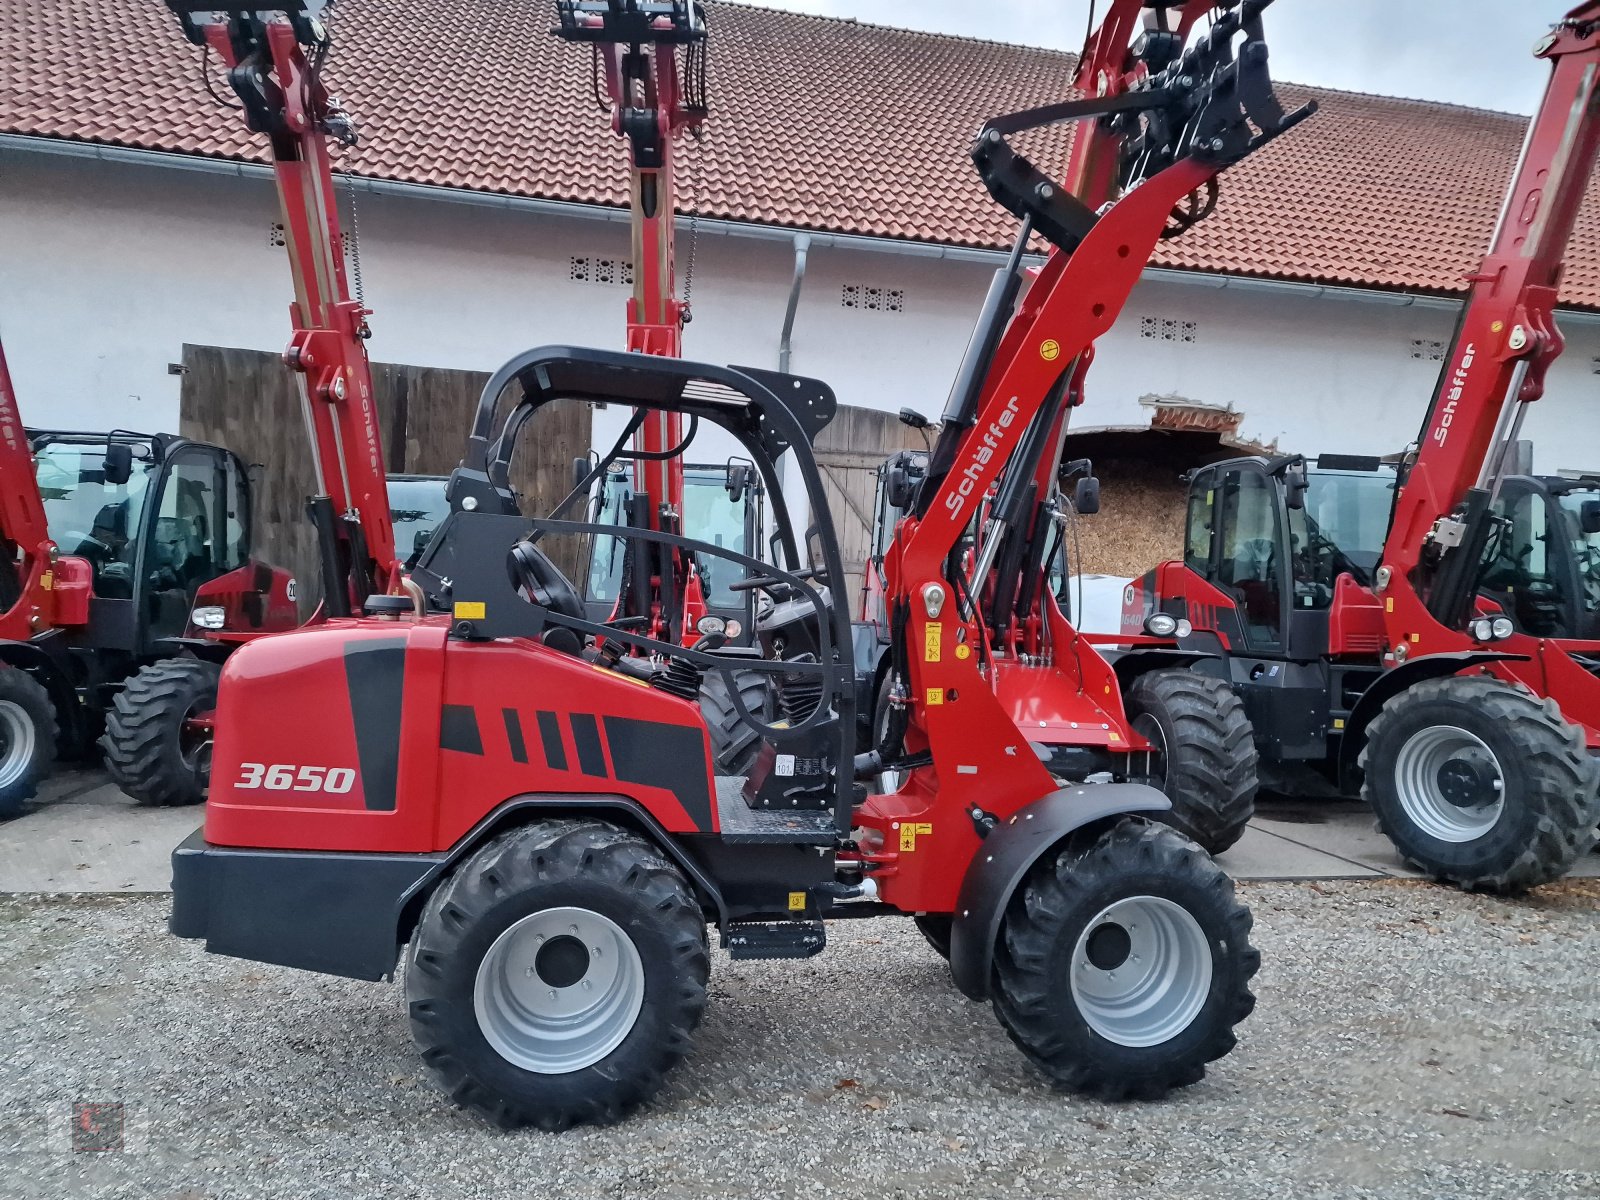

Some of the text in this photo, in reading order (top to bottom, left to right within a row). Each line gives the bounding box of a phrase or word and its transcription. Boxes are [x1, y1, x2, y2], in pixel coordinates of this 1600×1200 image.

[1434, 343, 1476, 448] Schäffer
[945, 396, 1019, 520] Schäffer
[233, 762, 356, 794] 3650
